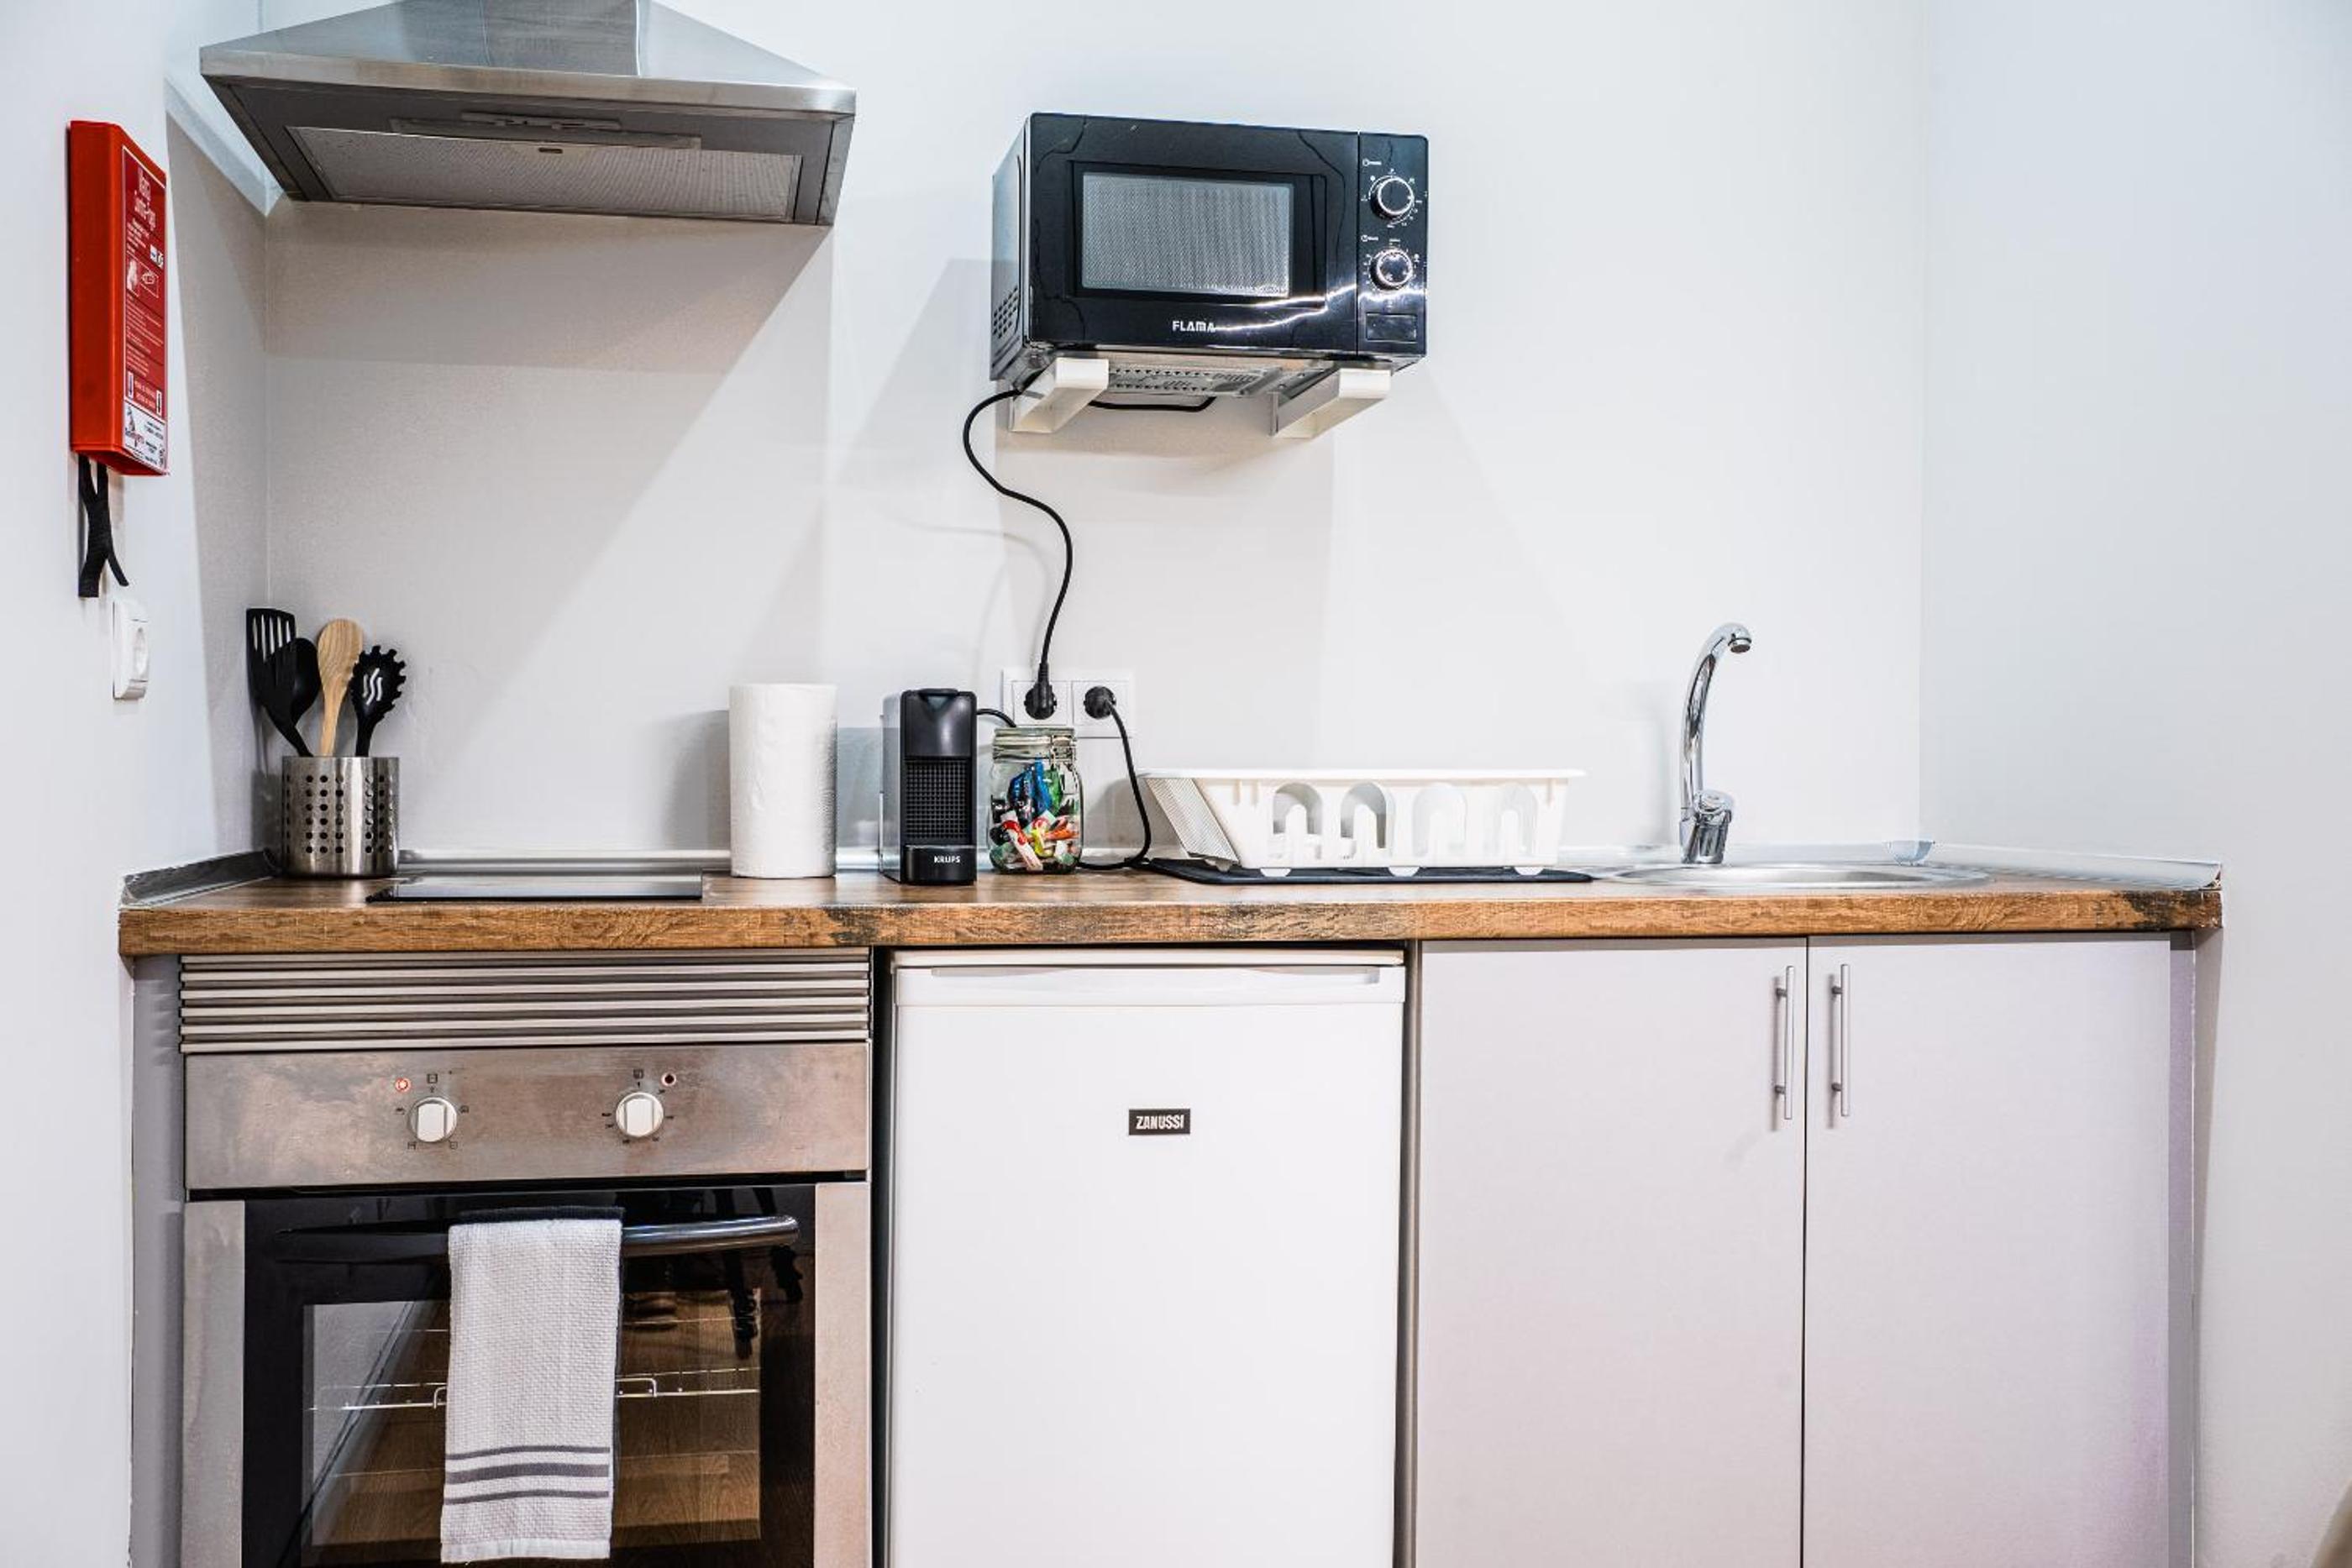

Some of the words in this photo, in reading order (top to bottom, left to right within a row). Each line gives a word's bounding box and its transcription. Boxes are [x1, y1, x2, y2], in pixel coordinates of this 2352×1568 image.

[1172, 320, 1216, 333] FLAMA
[934, 855, 961, 863] KRUPS
[1136, 1114, 1184, 1130] ZANUSSI
